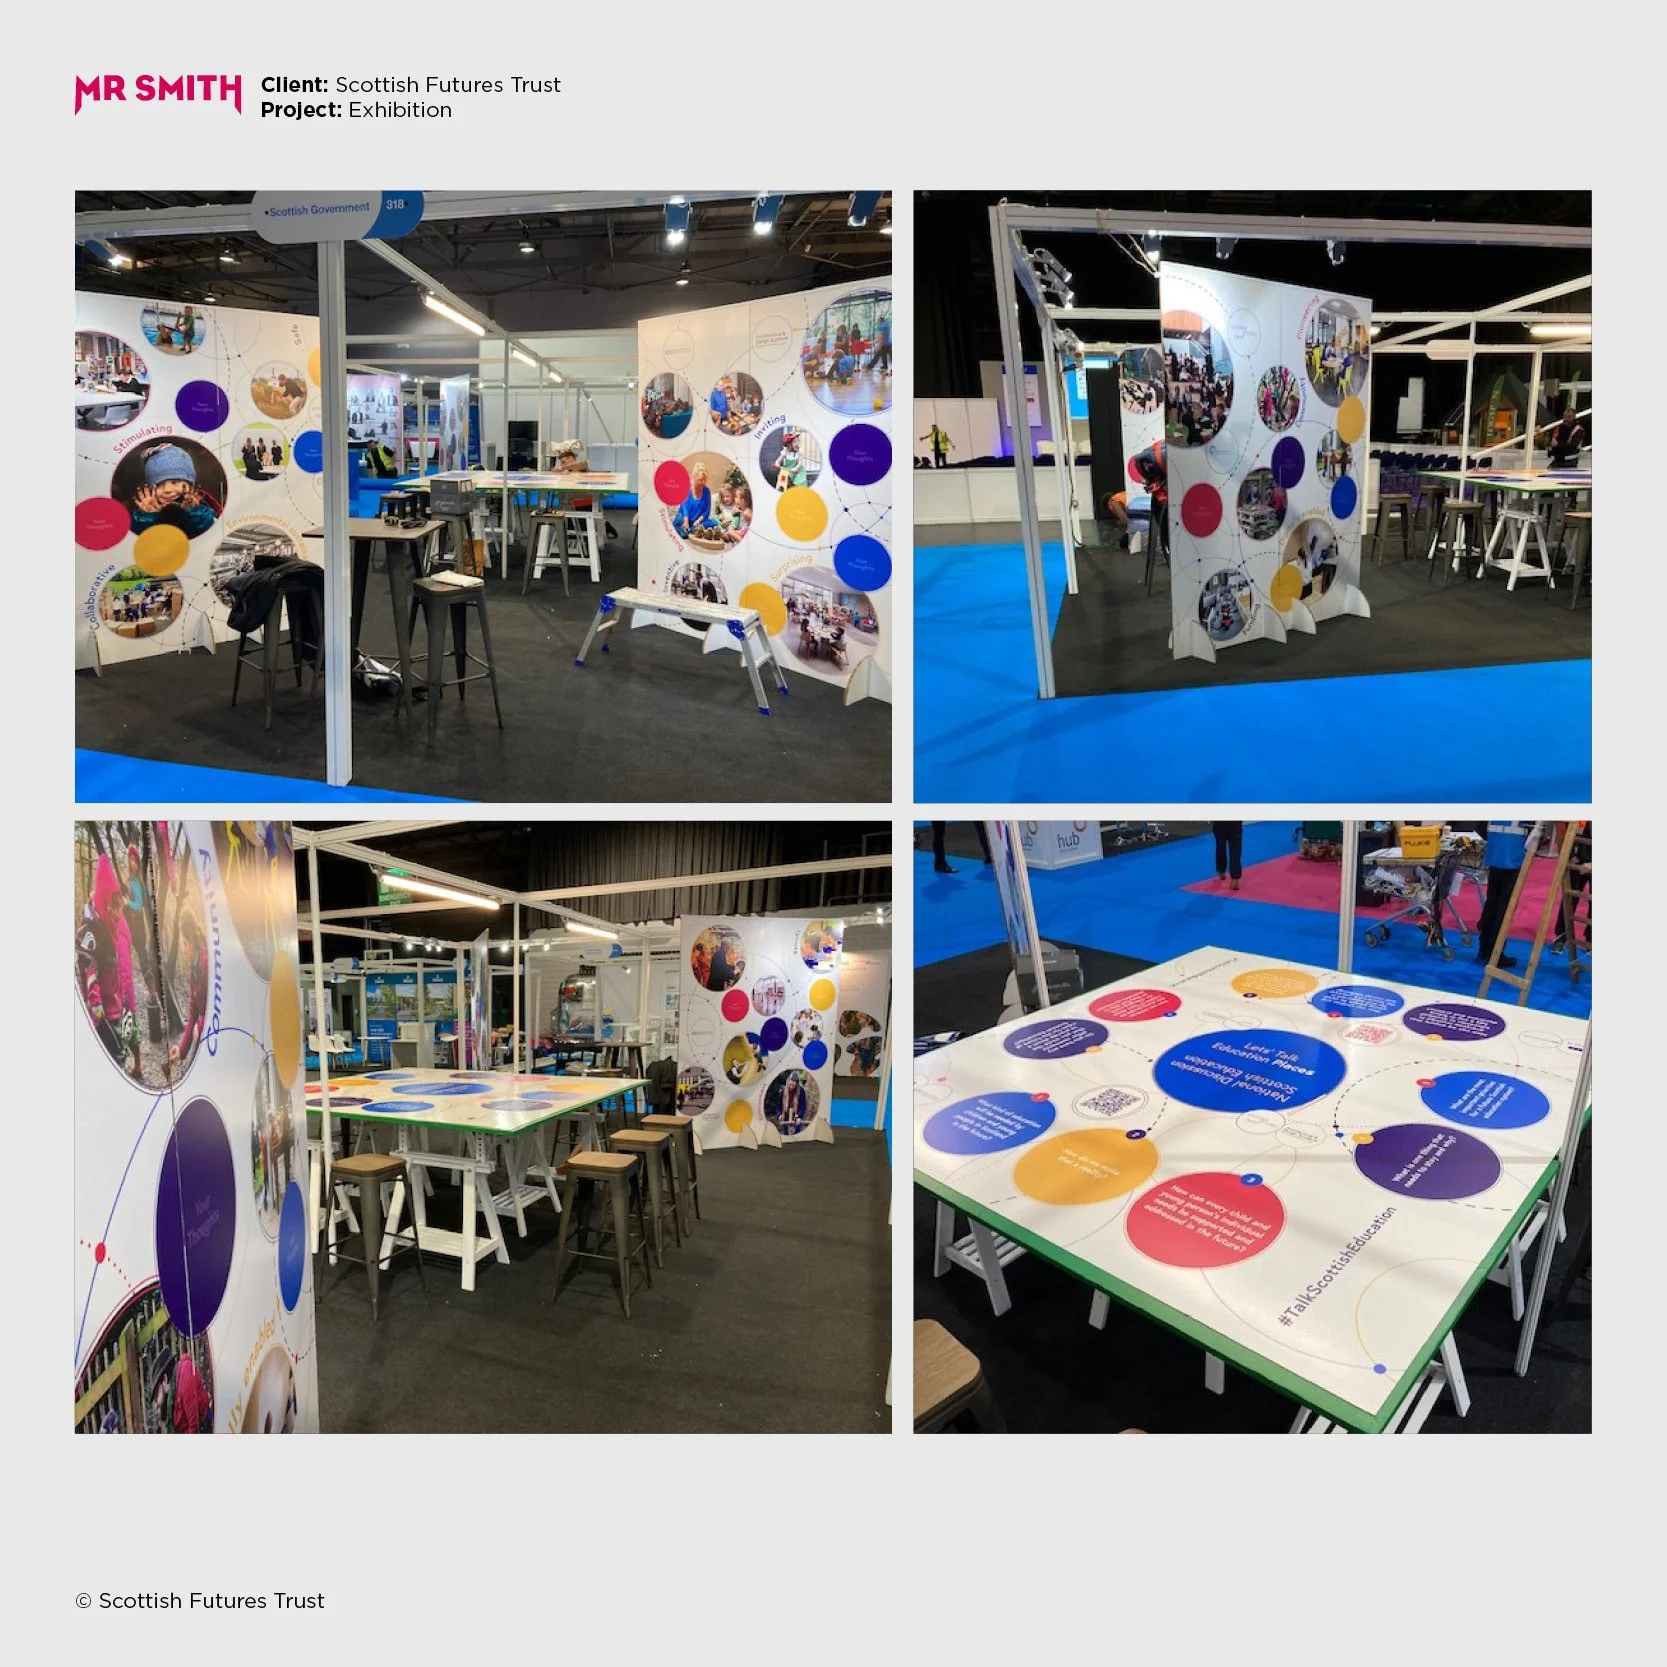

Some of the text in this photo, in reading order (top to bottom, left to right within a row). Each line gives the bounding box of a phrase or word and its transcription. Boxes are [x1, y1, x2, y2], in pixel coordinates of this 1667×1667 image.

[270, 202, 370, 217] Scottish Government
[386, 199, 404, 210] 318
[113, 425, 173, 453] Stimulating
[754, 414, 786, 439] Inviting
[771, 555, 812, 581] Surprising
[84, 564, 116, 630] Collaborative
[1057, 831, 1080, 848] hub
[1211, 1041, 1315, 1076] Education Places
[1154, 1198, 1255, 1246] needs be supported and
[1160, 1191, 1186, 1205] young
[1220, 1216, 1265, 1238] individual
[1171, 1184, 1271, 1231] How can every child and
[1143, 1204, 1247, 1253] addressed in the future?
[1277, 1206, 1397, 1328] #TalkScottishEducation
